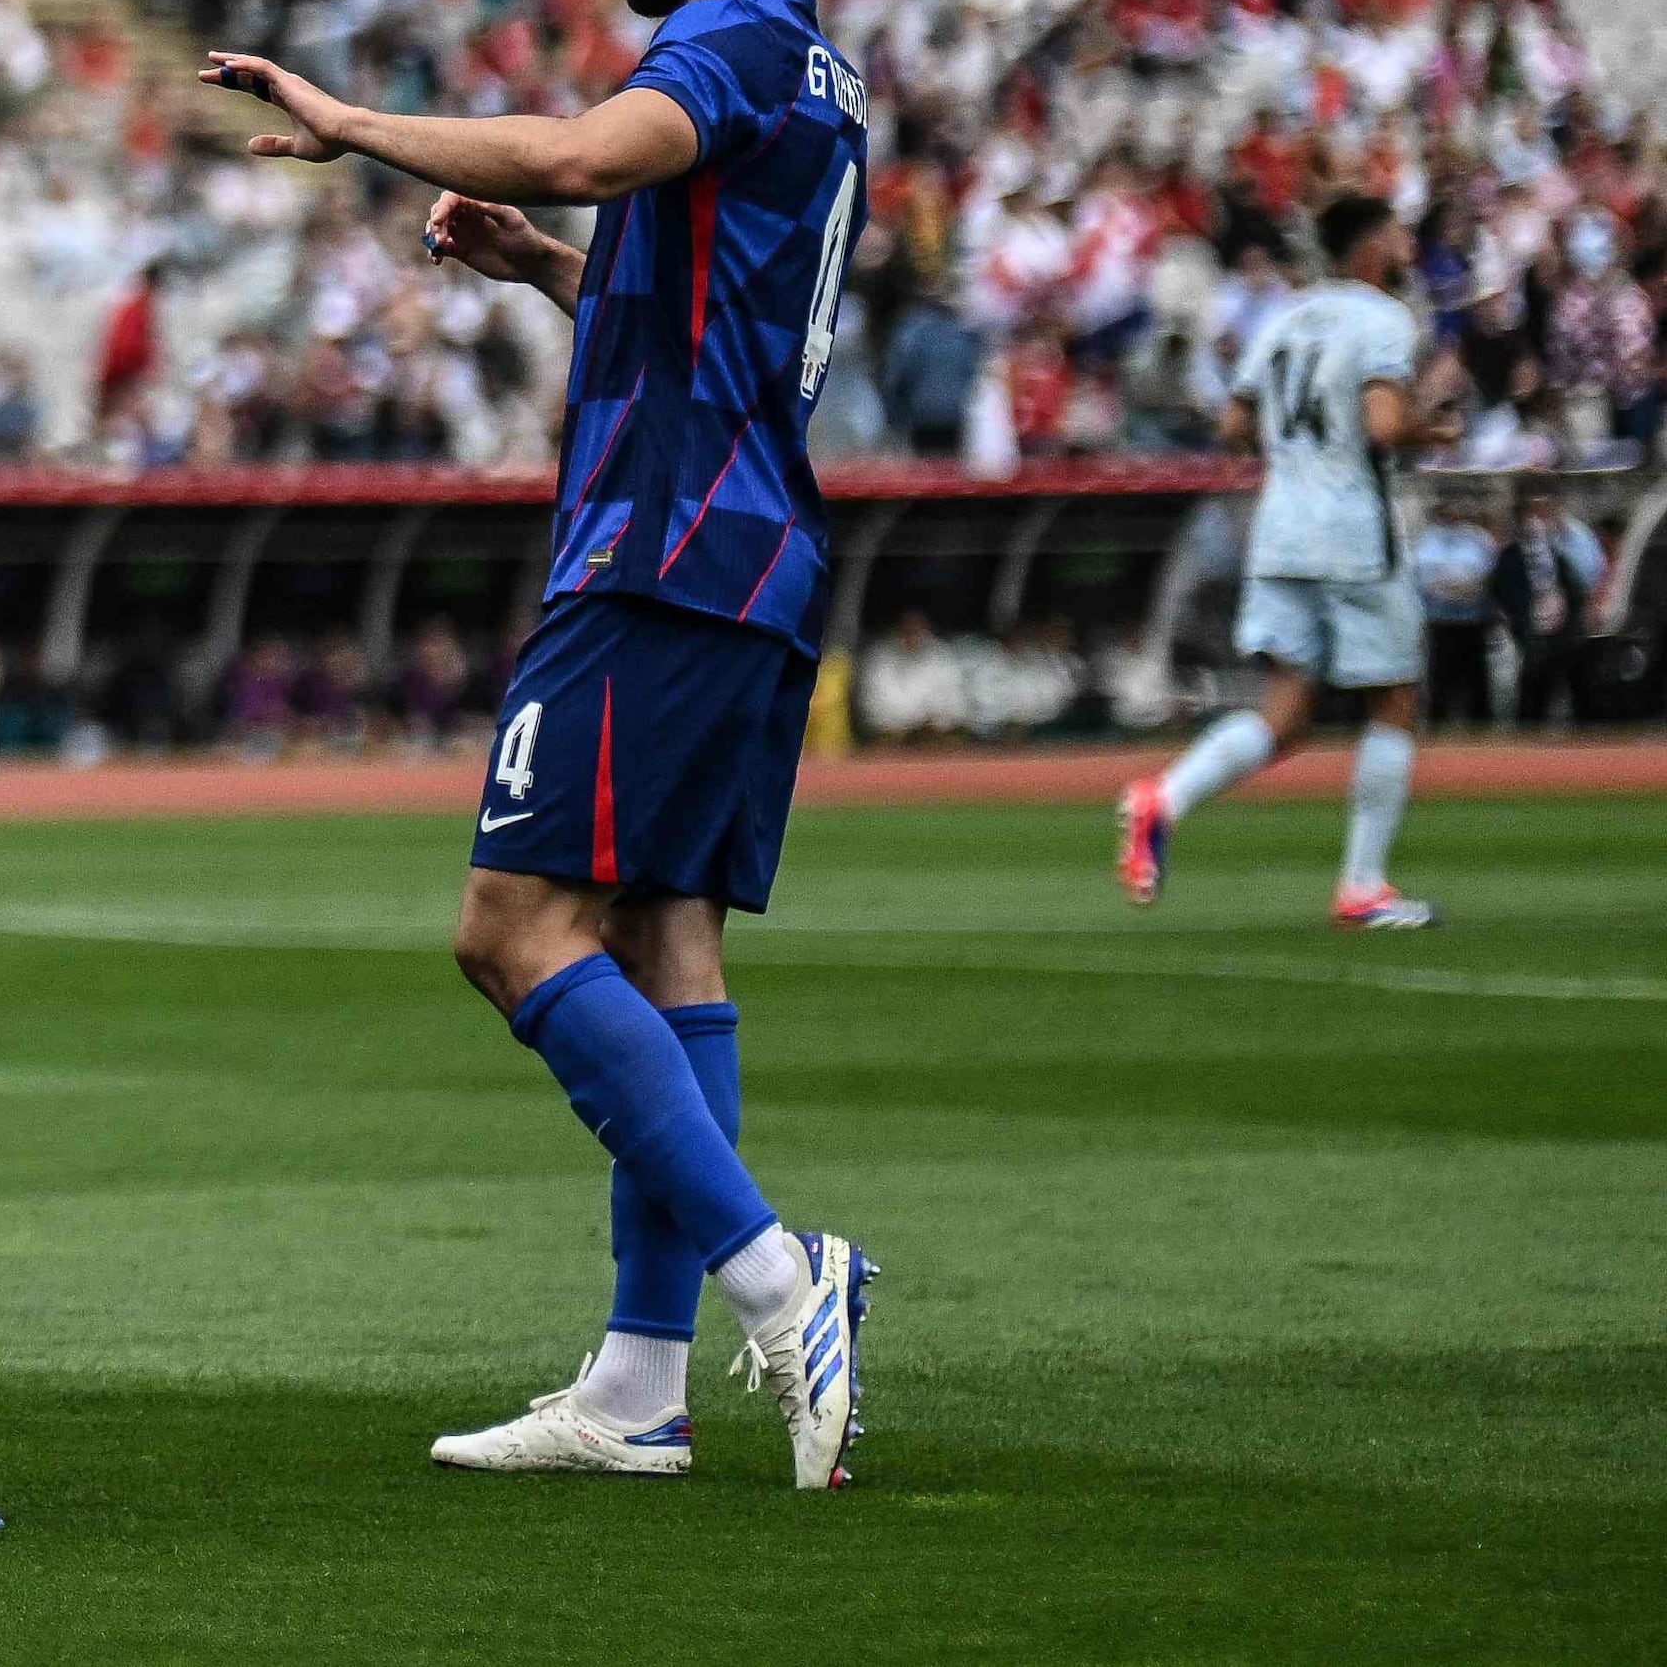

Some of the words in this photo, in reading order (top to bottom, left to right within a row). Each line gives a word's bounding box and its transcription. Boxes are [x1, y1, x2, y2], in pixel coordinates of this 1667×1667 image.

[801, 160, 857, 400] 4
[1272, 347, 1328, 444] 14
[496, 701, 543, 800] 4
